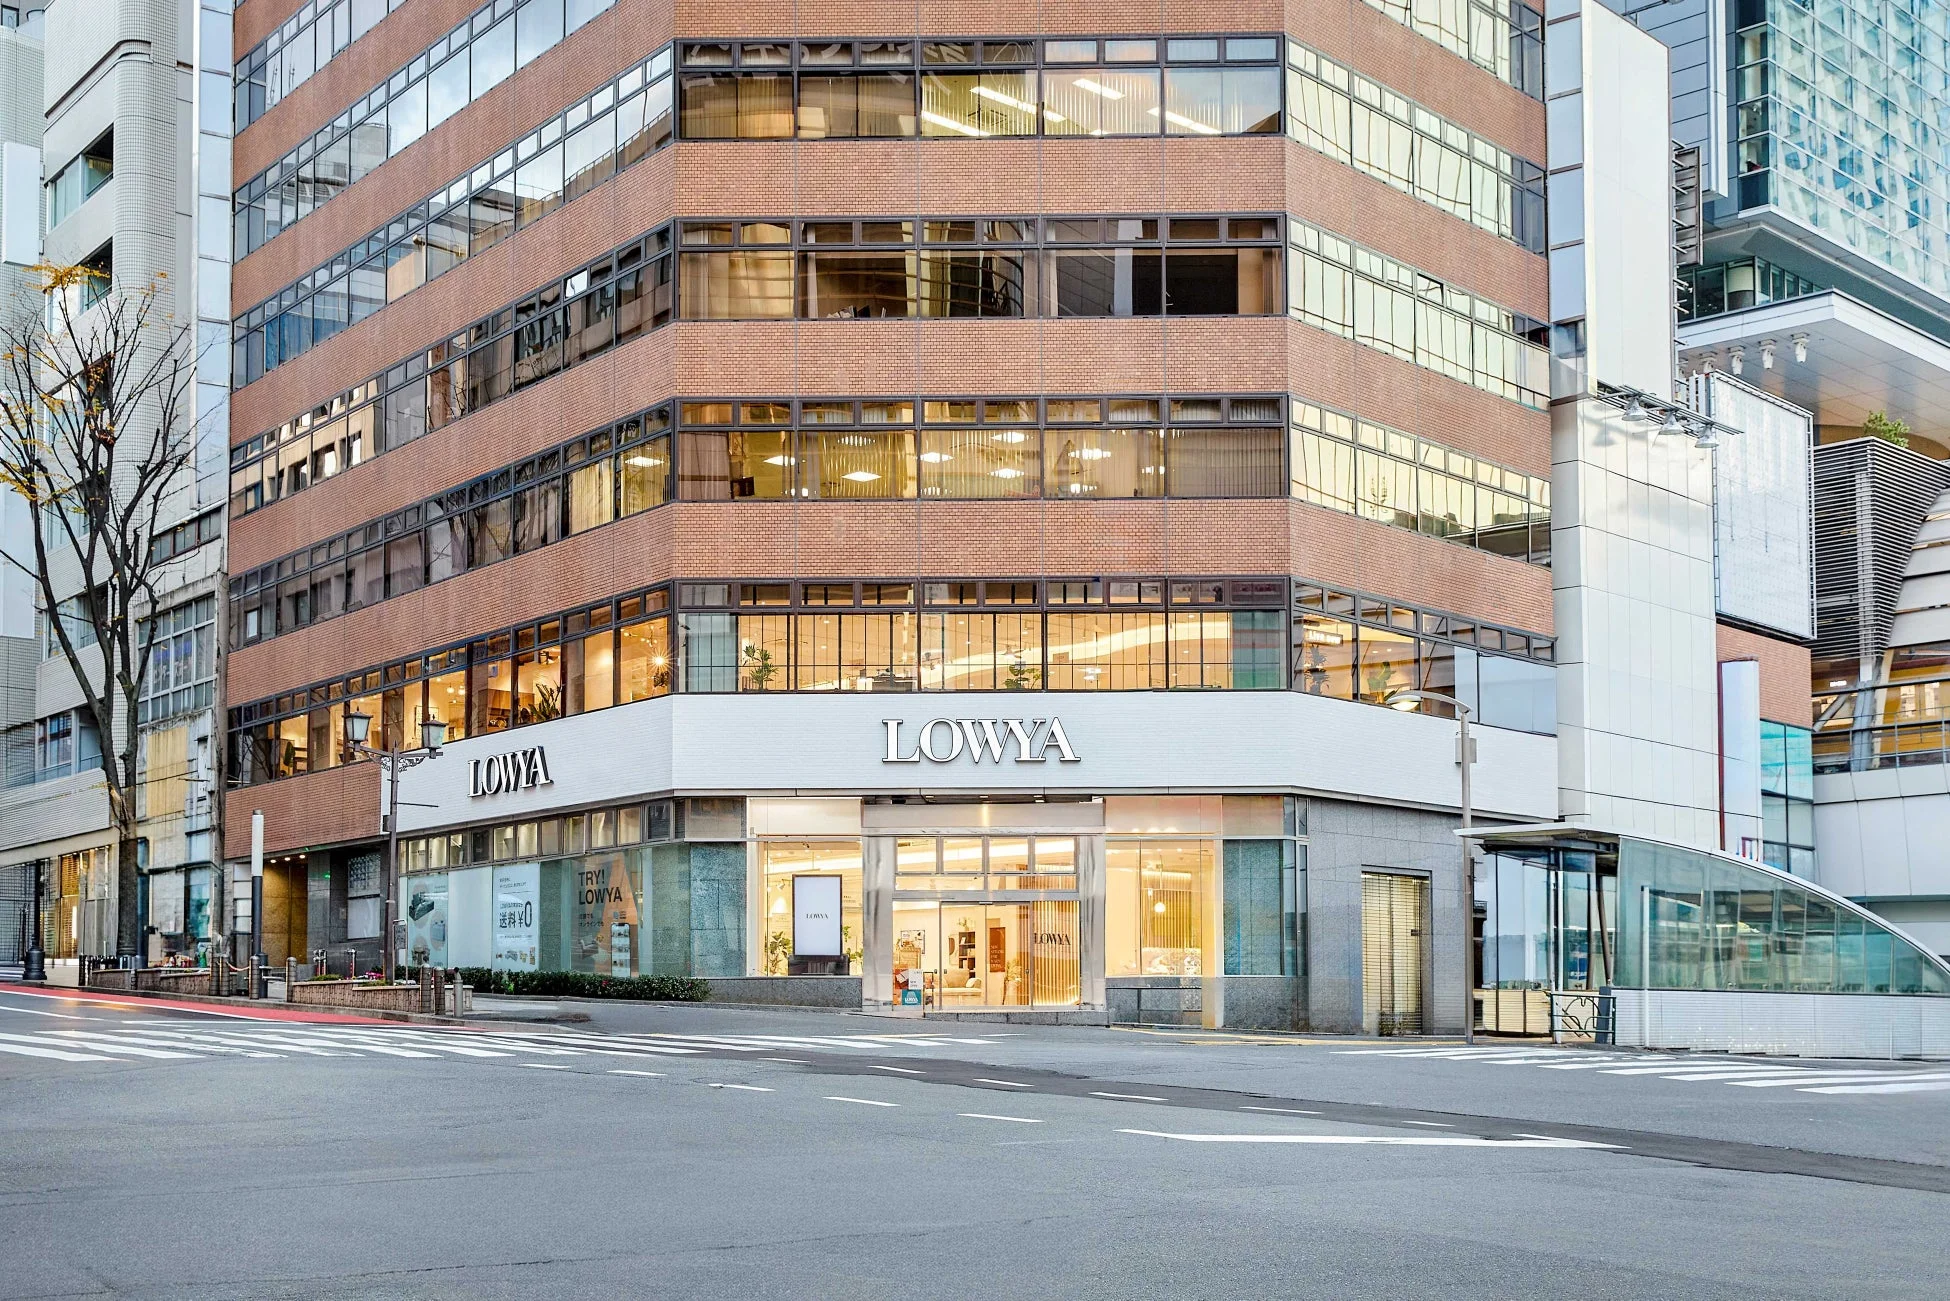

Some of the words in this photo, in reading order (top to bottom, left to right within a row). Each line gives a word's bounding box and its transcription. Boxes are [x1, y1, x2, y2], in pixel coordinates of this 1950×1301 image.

[882, 716, 1081, 763] LOWYA
[468, 745, 554, 797] LOWYA
[578, 869, 605, 886] TRY!
[578, 887, 622, 905] LOWYA
[1034, 932, 1071, 945] LOWYA
